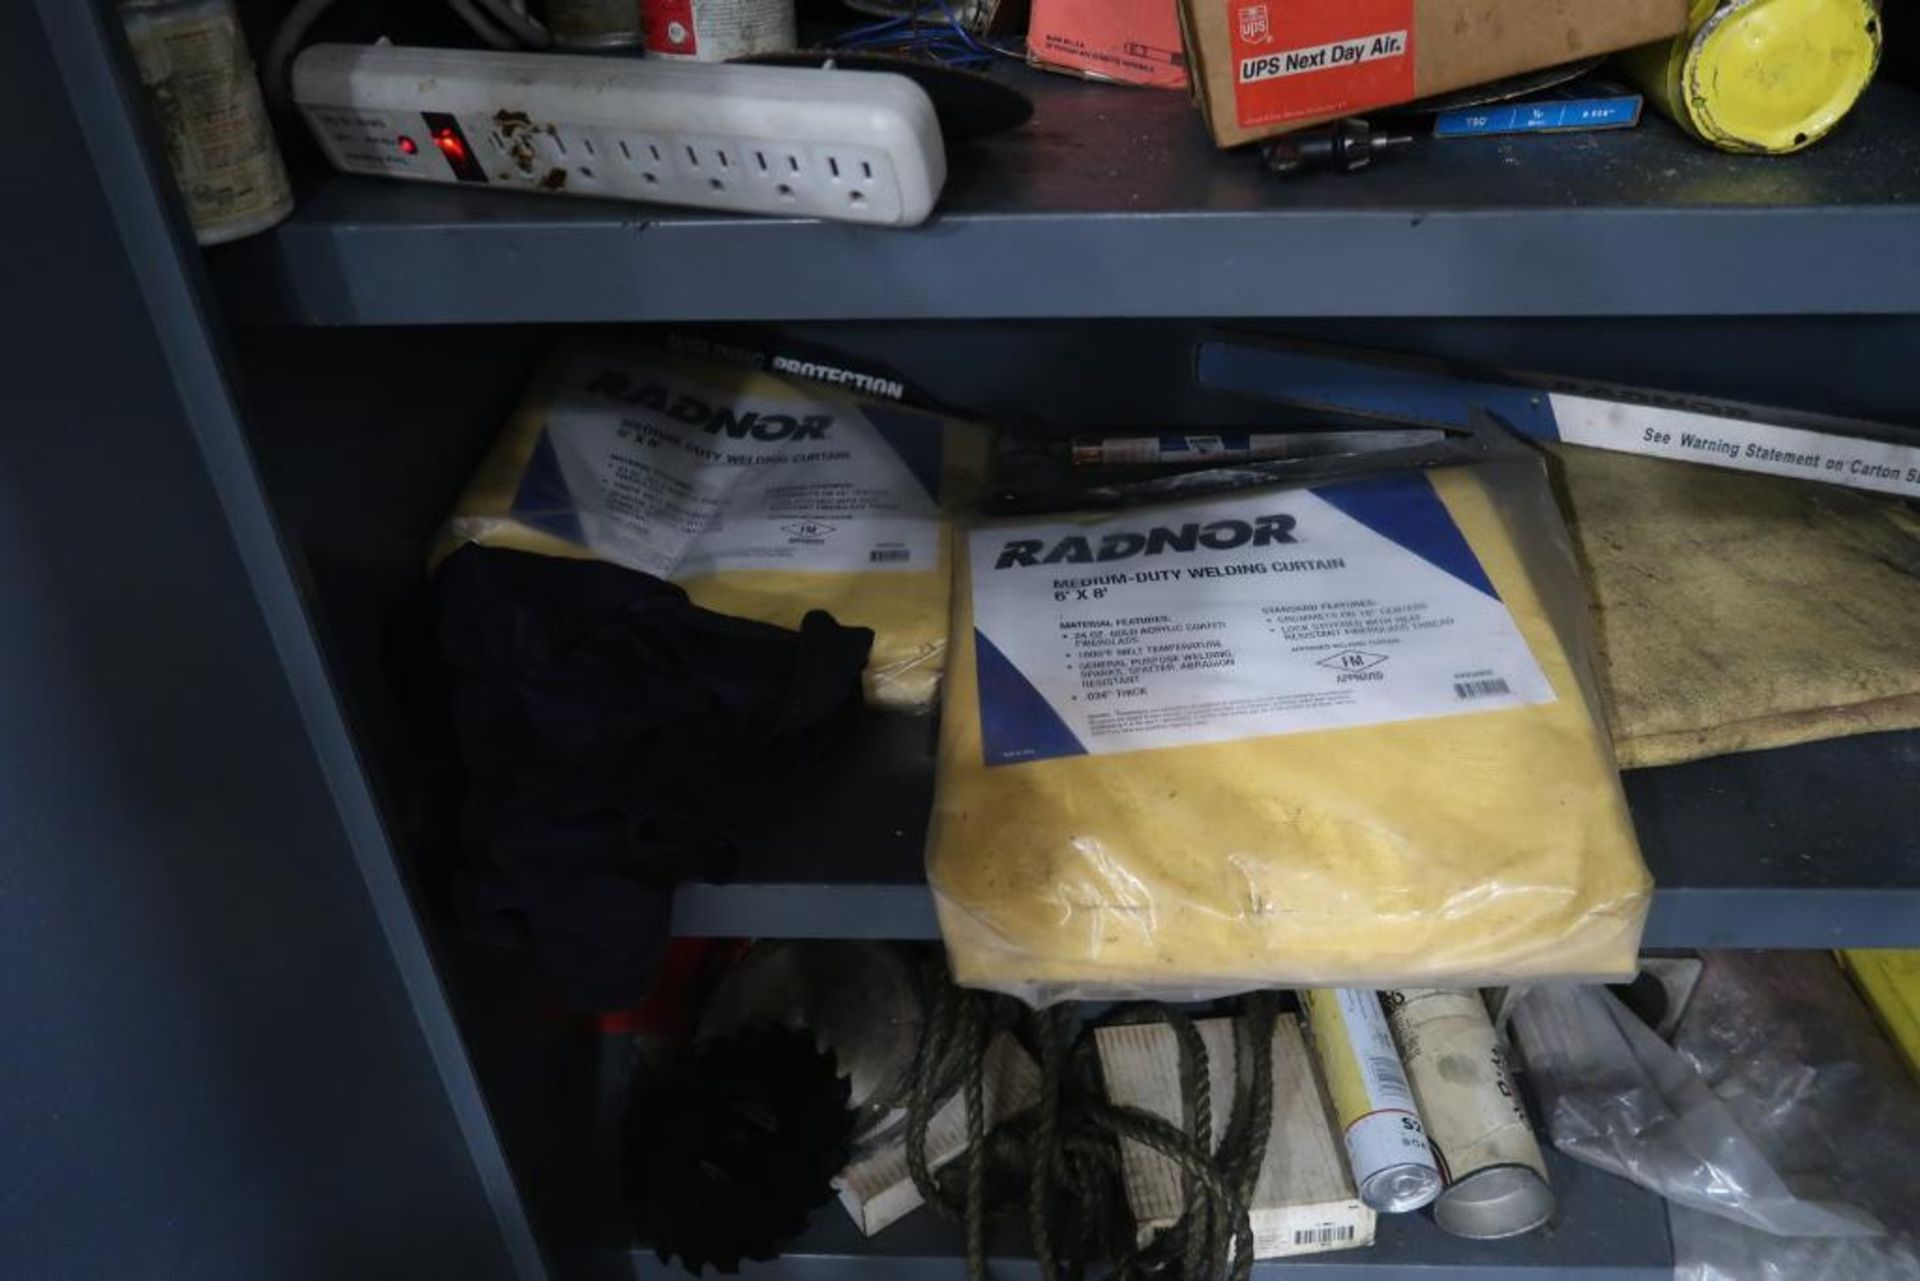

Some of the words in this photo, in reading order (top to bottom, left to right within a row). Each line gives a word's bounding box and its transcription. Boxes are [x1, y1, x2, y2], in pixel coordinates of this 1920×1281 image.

[1243, 21, 1266, 37] ups
[1243, 57, 1280, 79] UPS
[1285, 50, 1327, 71] Next
[1330, 44, 1366, 64] Day
[1370, 36, 1402, 56] Air.
[772, 356, 904, 400] PROTECTION
[586, 368, 834, 441] RADNOR
[791, 450, 852, 463] CURTAIN
[1643, 427, 1672, 445] See
[1679, 432, 1741, 458] Warning
[1745, 443, 1821, 469] Statement
[1825, 457, 1845, 472] on
[1850, 459, 1902, 481] Carton
[994, 513, 1300, 570] RADNOR
[1053, 567, 1182, 590] MEDIUM-DUTY
[1188, 560, 1268, 580] WELDING
[1271, 557, 1347, 573] CURTAIN
[1077, 588, 1089, 600] X
[1059, 619, 1112, 631] MATERIAL
[1116, 688, 1149, 699] THICK
